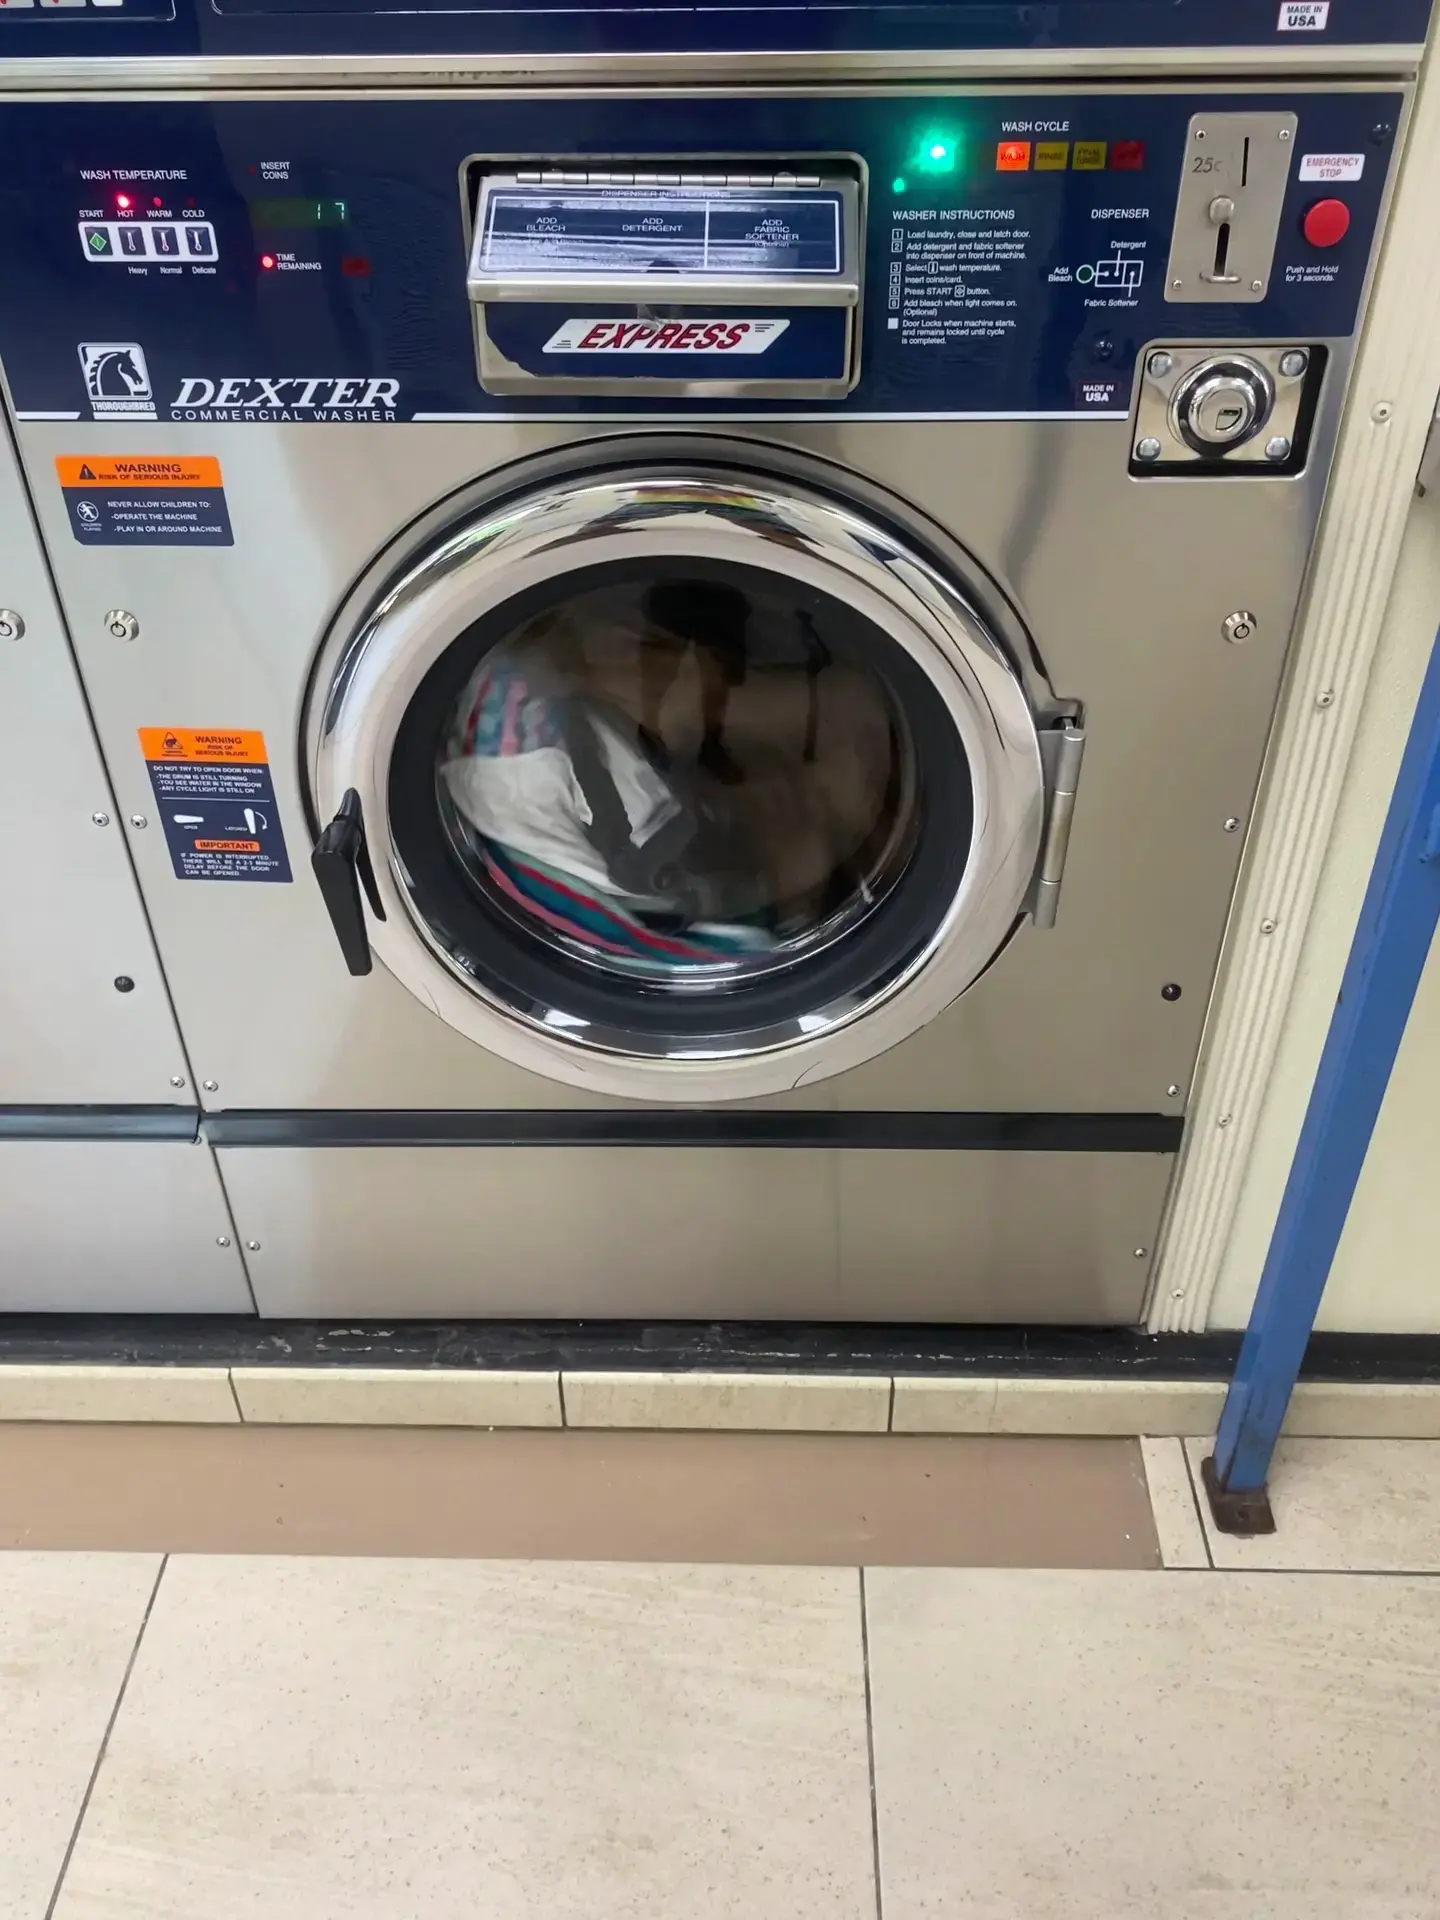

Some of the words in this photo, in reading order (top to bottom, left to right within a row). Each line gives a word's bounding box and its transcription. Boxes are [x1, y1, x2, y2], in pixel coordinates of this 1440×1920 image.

[1313, 5, 1323, 13] IN
[1288, 15, 1317, 27] USA
[1001, 121, 1033, 132] WASH
[1034, 120, 1070, 132] CYCLE
[260, 161, 291, 170] INSERT
[1306, 157, 1361, 167] EMERGENCY
[80, 170, 111, 180] WASH
[112, 170, 188, 180] TEMPERATURE
[262, 171, 289, 180] COINS
[1319, 168, 1342, 178] STOP
[79, 210, 105, 218] START
[117, 210, 134, 218] HOT
[146, 210, 173, 218] WARM
[182, 210, 205, 218] COLD
[892, 210, 937, 220] WASHER
[940, 209, 1016, 220] INSTRUCTIONS
[1090, 208, 1150, 219] DISPENSER
[642, 217, 664, 225] ADD
[526, 224, 566, 232] BLEACH
[622, 224, 684, 232] DETERGENT
[745, 233, 800, 241] SOFTENER
[907, 230, 926, 239] Load
[927, 230, 956, 240] laundry,
[957, 230, 977, 239] close
[978, 230, 992, 239] and
[993, 230, 1011, 239] latch
[1012, 230, 1031, 239] door.
[906, 242, 922, 251] Add
[922, 243, 957, 252] detergent
[958, 243, 973, 251] and
[973, 242, 994, 251] fabric
[995, 242, 1025, 251] softener
[1110, 240, 1147, 250] Detergent
[276, 253, 296, 261] TIME
[905, 252, 920, 260] into
[920, 252, 956, 262] dispenser
[957, 252, 968, 260] on
[968, 251, 985, 260] front
[985, 251, 995, 260] of
[994, 251, 1028, 260] machine.
[128, 266, 148, 276] Heavy
[160, 266, 183, 275] Normal
[192, 266, 217, 275] Delicate
[277, 262, 322, 271] REMAINING
[905, 263, 927, 272] Select
[939, 264, 958, 272] wash
[958, 263, 1003, 273] temperature.
[1053, 267, 1070, 275] Add
[1285, 265, 1305, 274] Push
[1305, 265, 1321, 274] and
[1321, 265, 1339, 274] Hold
[904, 276, 925, 284] Insert
[1048, 274, 1073, 283] Bleach
[1285, 274, 1296, 282] for
[1296, 274, 1303, 282] 3
[1303, 274, 1335, 282] seconds.
[903, 287, 926, 296] Press
[926, 286, 953, 296] START
[967, 287, 992, 296] button.
[903, 298, 919, 307] Add
[919, 298, 944, 307] bleach
[944, 299, 964, 307] when
[965, 298, 980, 308] light
[981, 299, 1006, 307] comes
[1005, 299, 1018, 307] on.
[1084, 299, 1107, 308] Fabric
[1108, 299, 1139, 308] Softener
[903, 308, 938, 317] (Optional)
[902, 319, 921, 328] Door
[921, 319, 943, 328] Locks
[943, 319, 963, 328] when
[963, 319, 994, 328] machine
[995, 319, 1017, 329] starts,
[576, 322, 751, 350] EXPRESS
[901, 328, 916, 337] and
[916, 328, 946, 337] remains
[946, 328, 970, 337] locked
[970, 327, 987, 336] until
[986, 327, 1006, 338] cycle
[901, 336, 909, 345] is
[908, 336, 948, 346] completed.
[170, 377, 401, 408] DEXTER
[1082, 384, 1105, 392] MADE
[1105, 384, 1115, 392] IN
[1085, 392, 1110, 402] USA
[90, 401, 156, 411] THOROUGHBRED
[171, 410, 304, 421] COMMERCIAL
[314, 410, 397, 421] WASHER
[114, 463, 182, 473] WARNING
[107, 501, 133, 509] NEVER
[133, 501, 160, 509] ALLOW
[160, 501, 197, 509] CHILDREN
[111, 513, 148, 521] -OPERATE
[148, 513, 163, 521] THE
[164, 513, 198, 521] MACHINE
[114, 525, 135, 533] -PLAY
[136, 525, 144, 533] IN
[145, 525, 157, 533] OR
[157, 525, 189, 533] AROUND
[189, 525, 223, 533] MACHINE
[194, 735, 243, 745] WARNING
[199, 841, 255, 850] IMPORTANT
